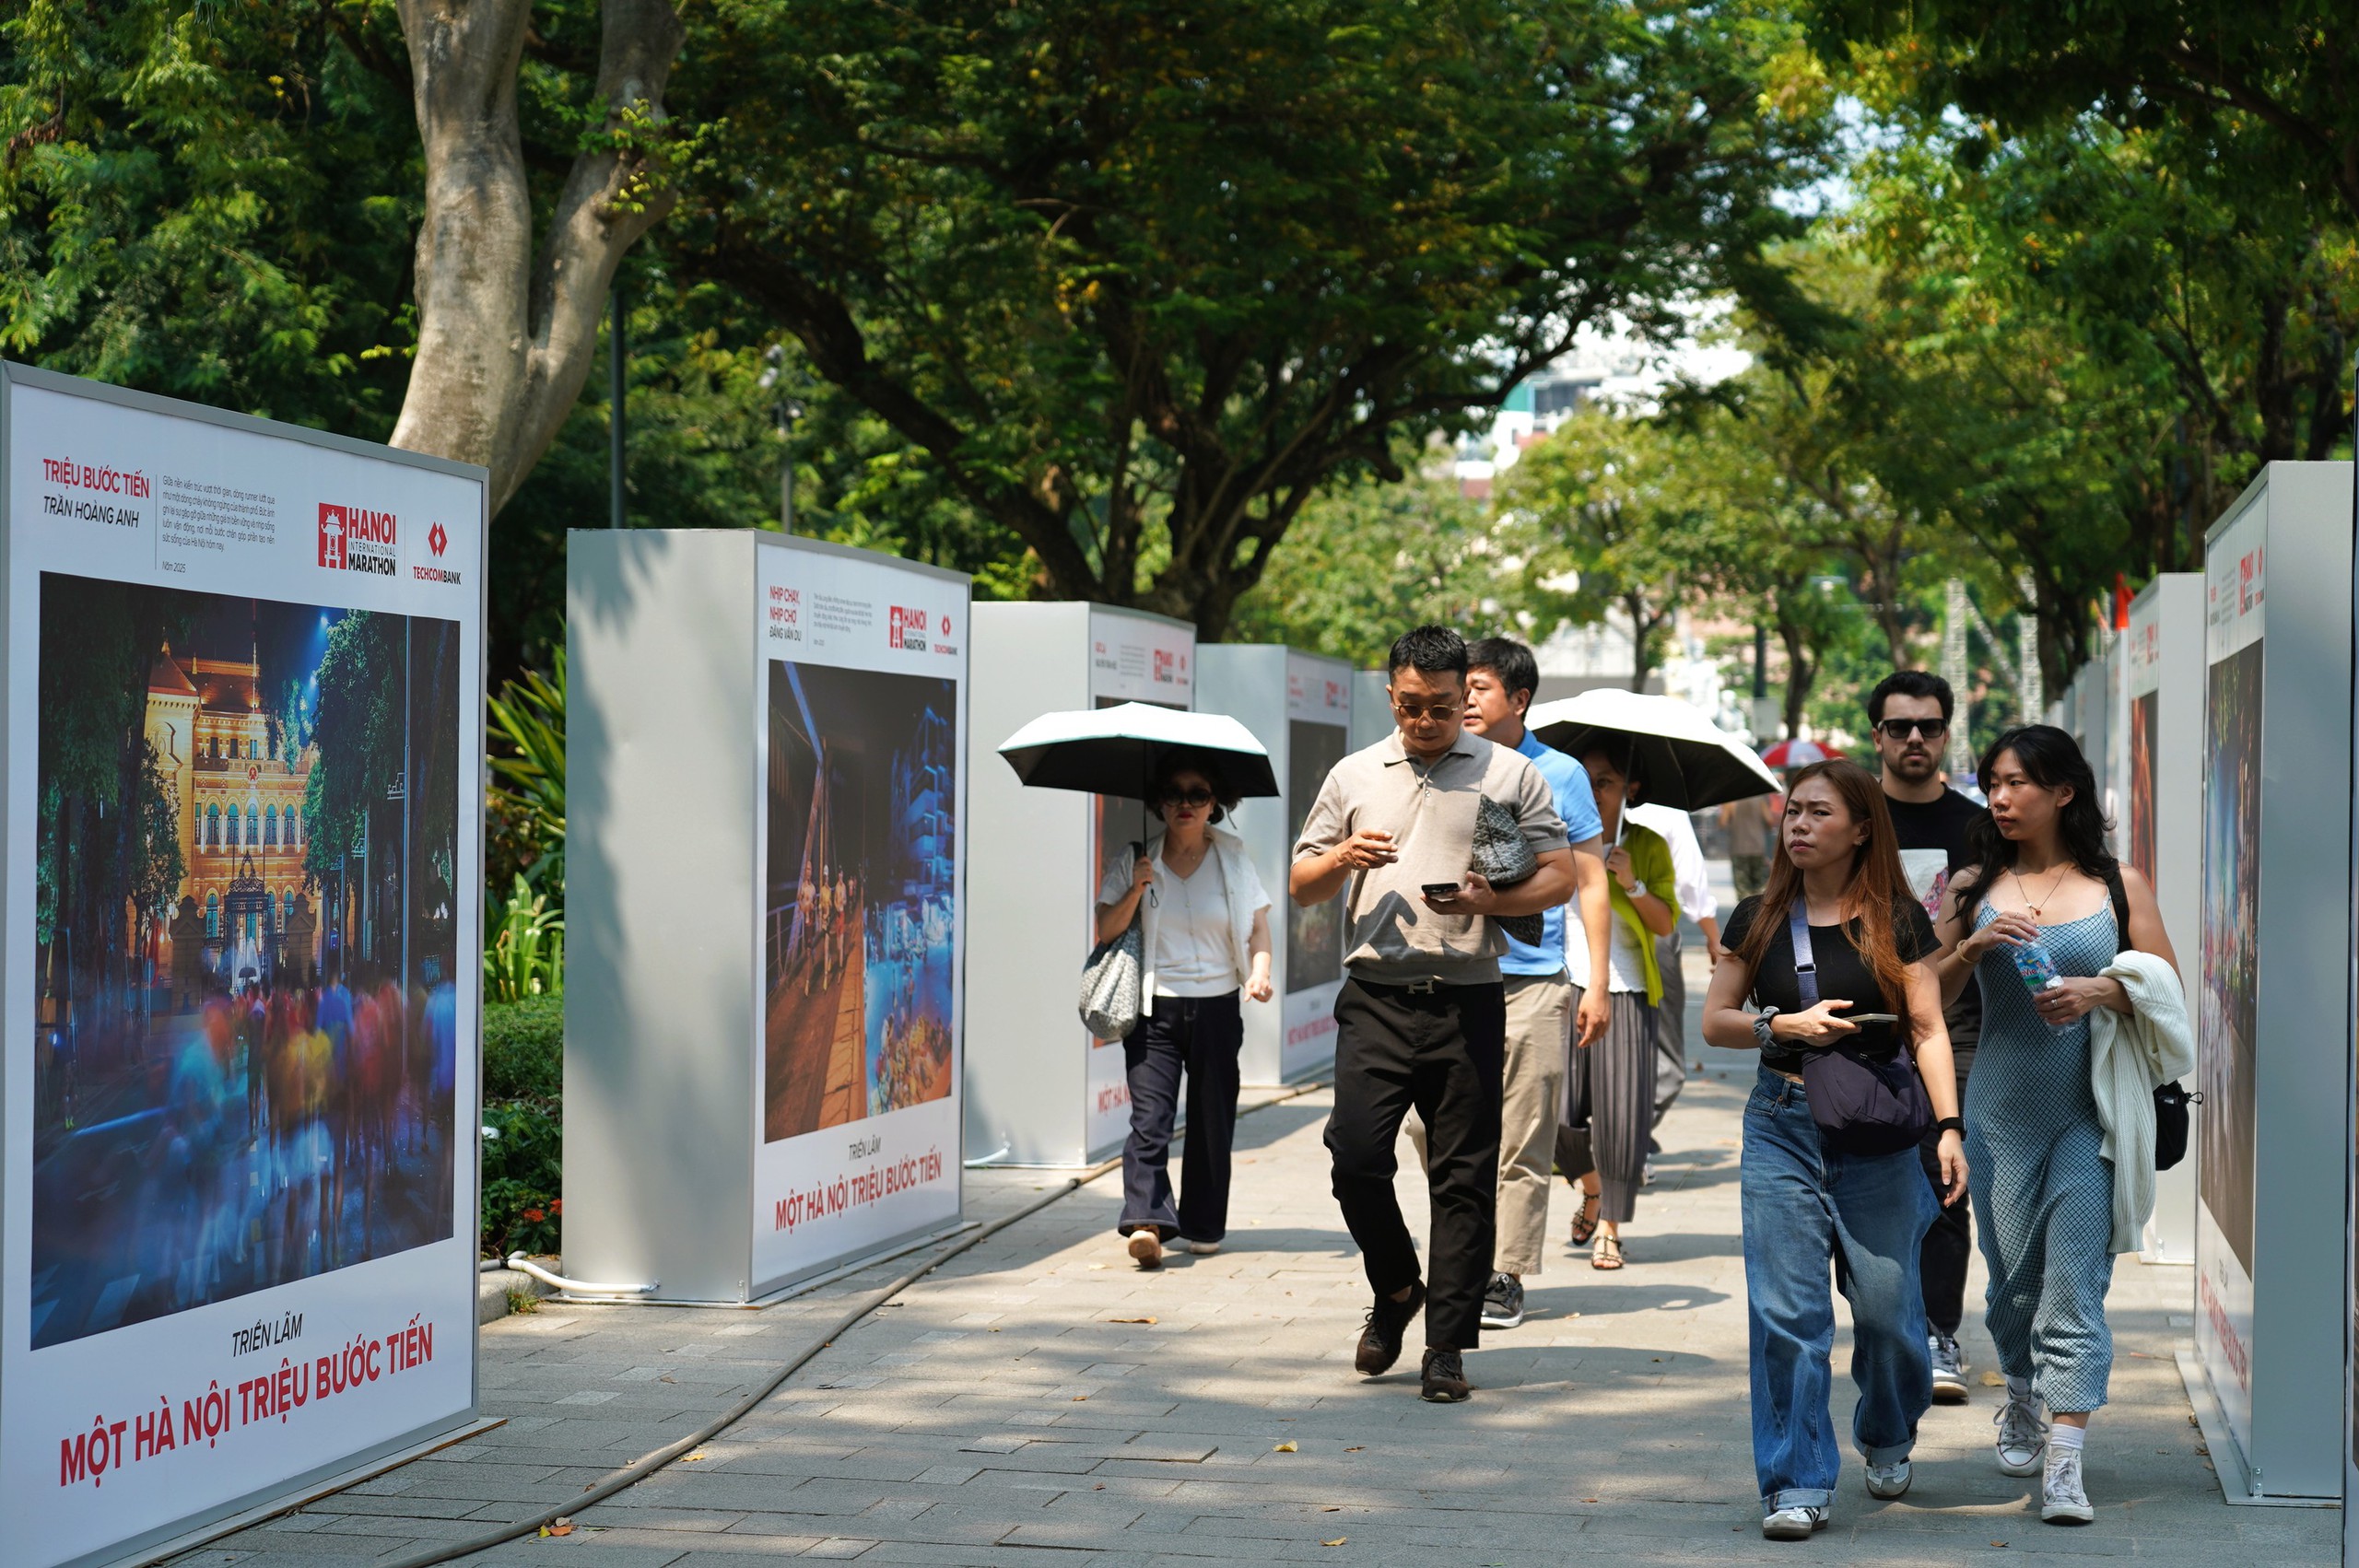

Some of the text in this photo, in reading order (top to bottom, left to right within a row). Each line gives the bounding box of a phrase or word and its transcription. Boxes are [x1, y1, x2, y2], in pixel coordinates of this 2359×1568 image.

[43, 456, 149, 498] TRIỆU BƯỚC TIẾN
[44, 494, 139, 528] TRẦN HOÀNG ANH
[349, 508, 396, 545] HANOI
[348, 541, 396, 557] INTERNATIONAL
[349, 553, 396, 576] MARATHON
[174, 562, 186, 573] 2025
[413, 566, 461, 585] TECHCOMBANK
[904, 608, 927, 631] HANOI
[776, 1144, 942, 1235] MỘT HÀ NỘI TRIỆU BƯỚC TIẾN
[232, 1311, 303, 1357] TRIỂN LÃM
[61, 1312, 433, 1488] MỘT HÀ NỘI TRIỆU BƯỚC TIẾN
